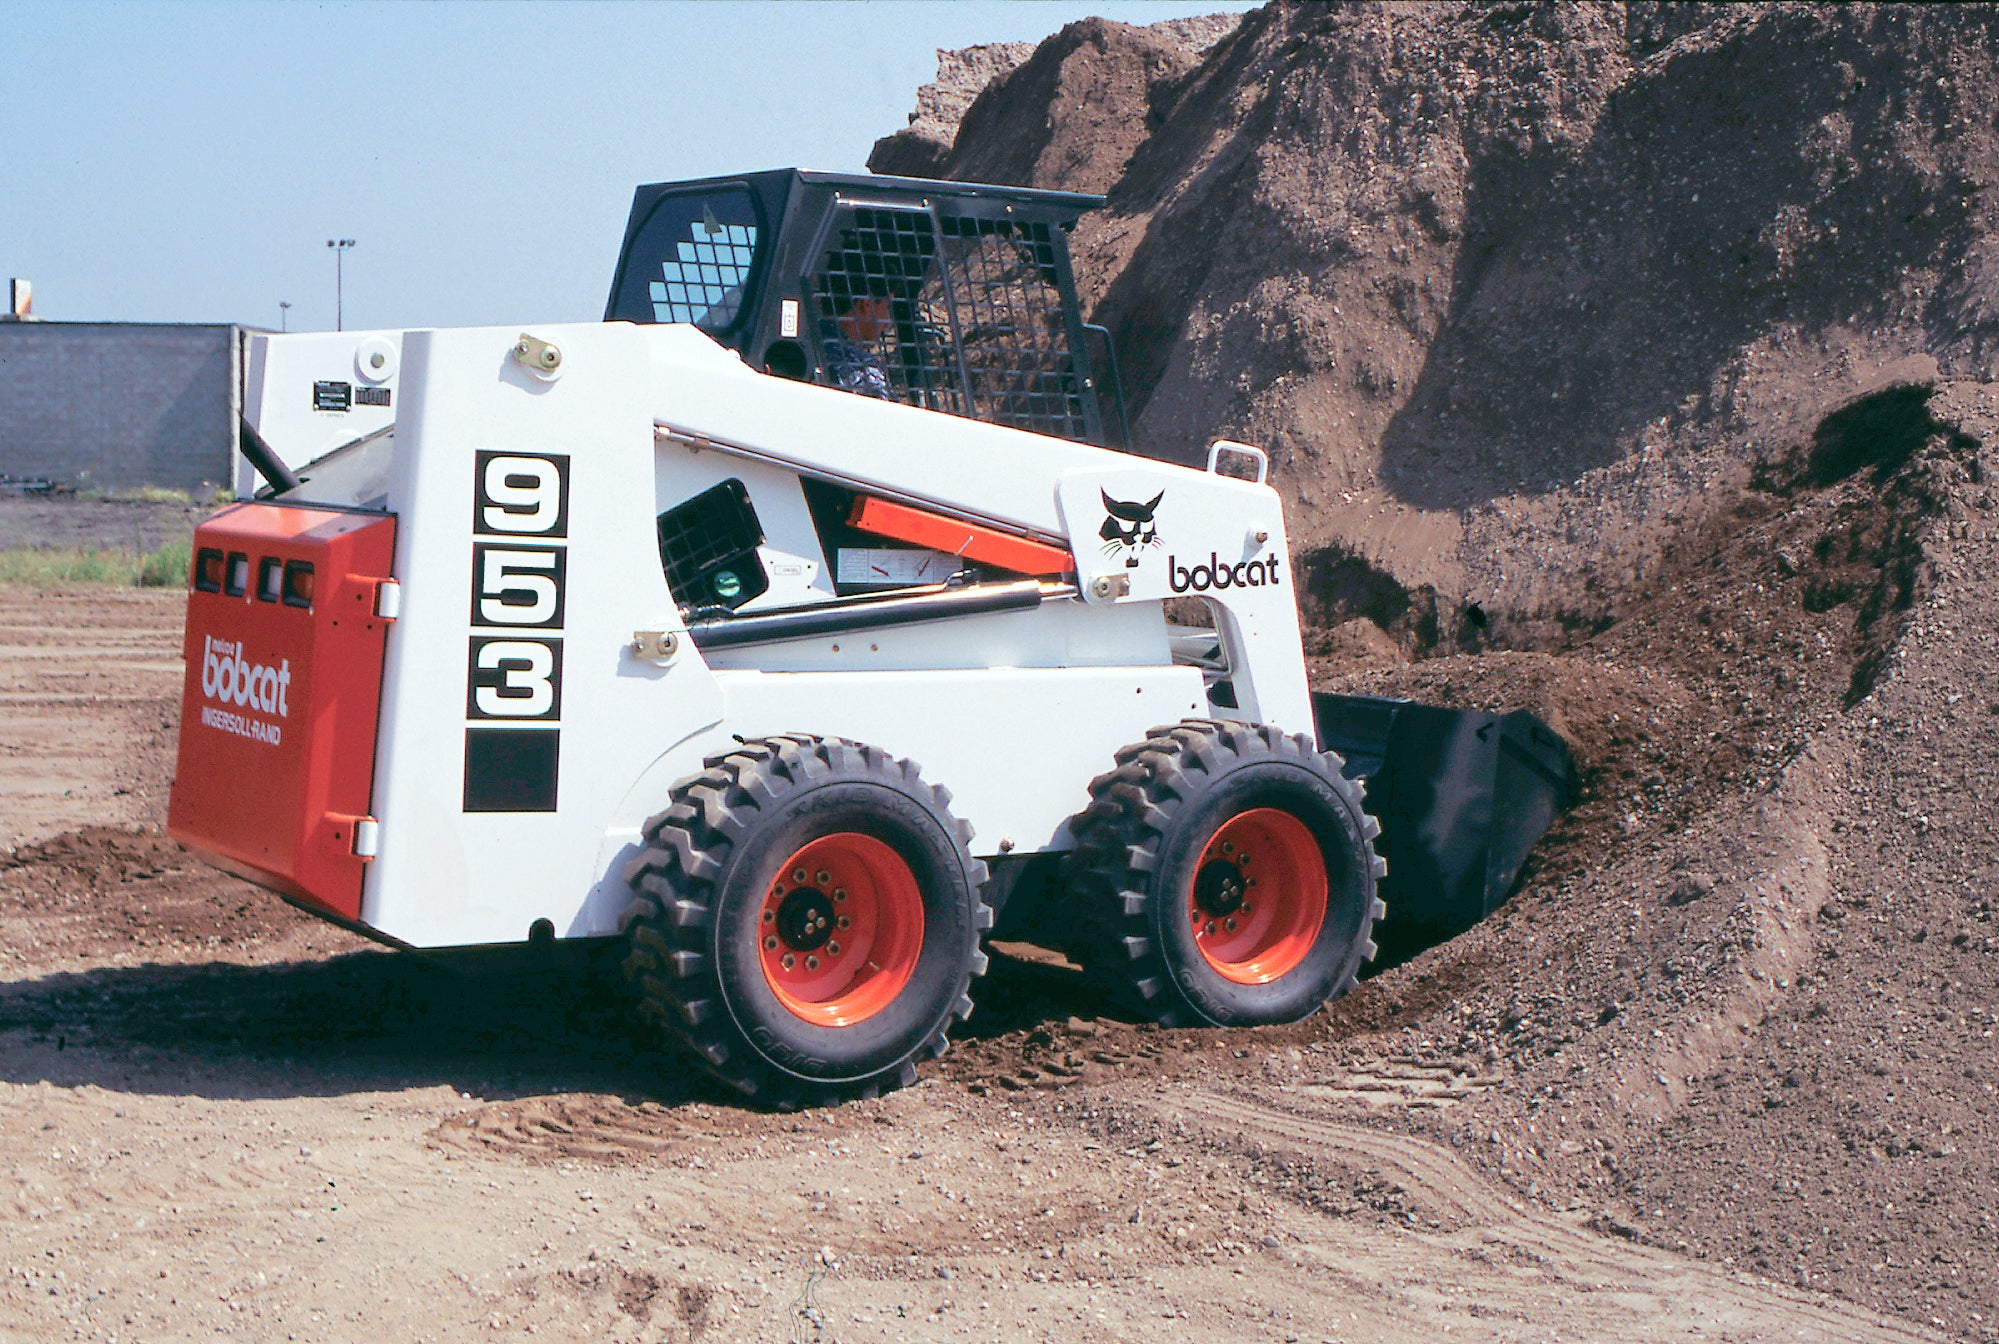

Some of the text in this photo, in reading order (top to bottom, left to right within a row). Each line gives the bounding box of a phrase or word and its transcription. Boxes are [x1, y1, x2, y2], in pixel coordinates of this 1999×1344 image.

[1168, 551, 1280, 593] bobcat
[202, 633, 291, 718] bobcat
[201, 706, 282, 746] INGERSOLL-RAND
